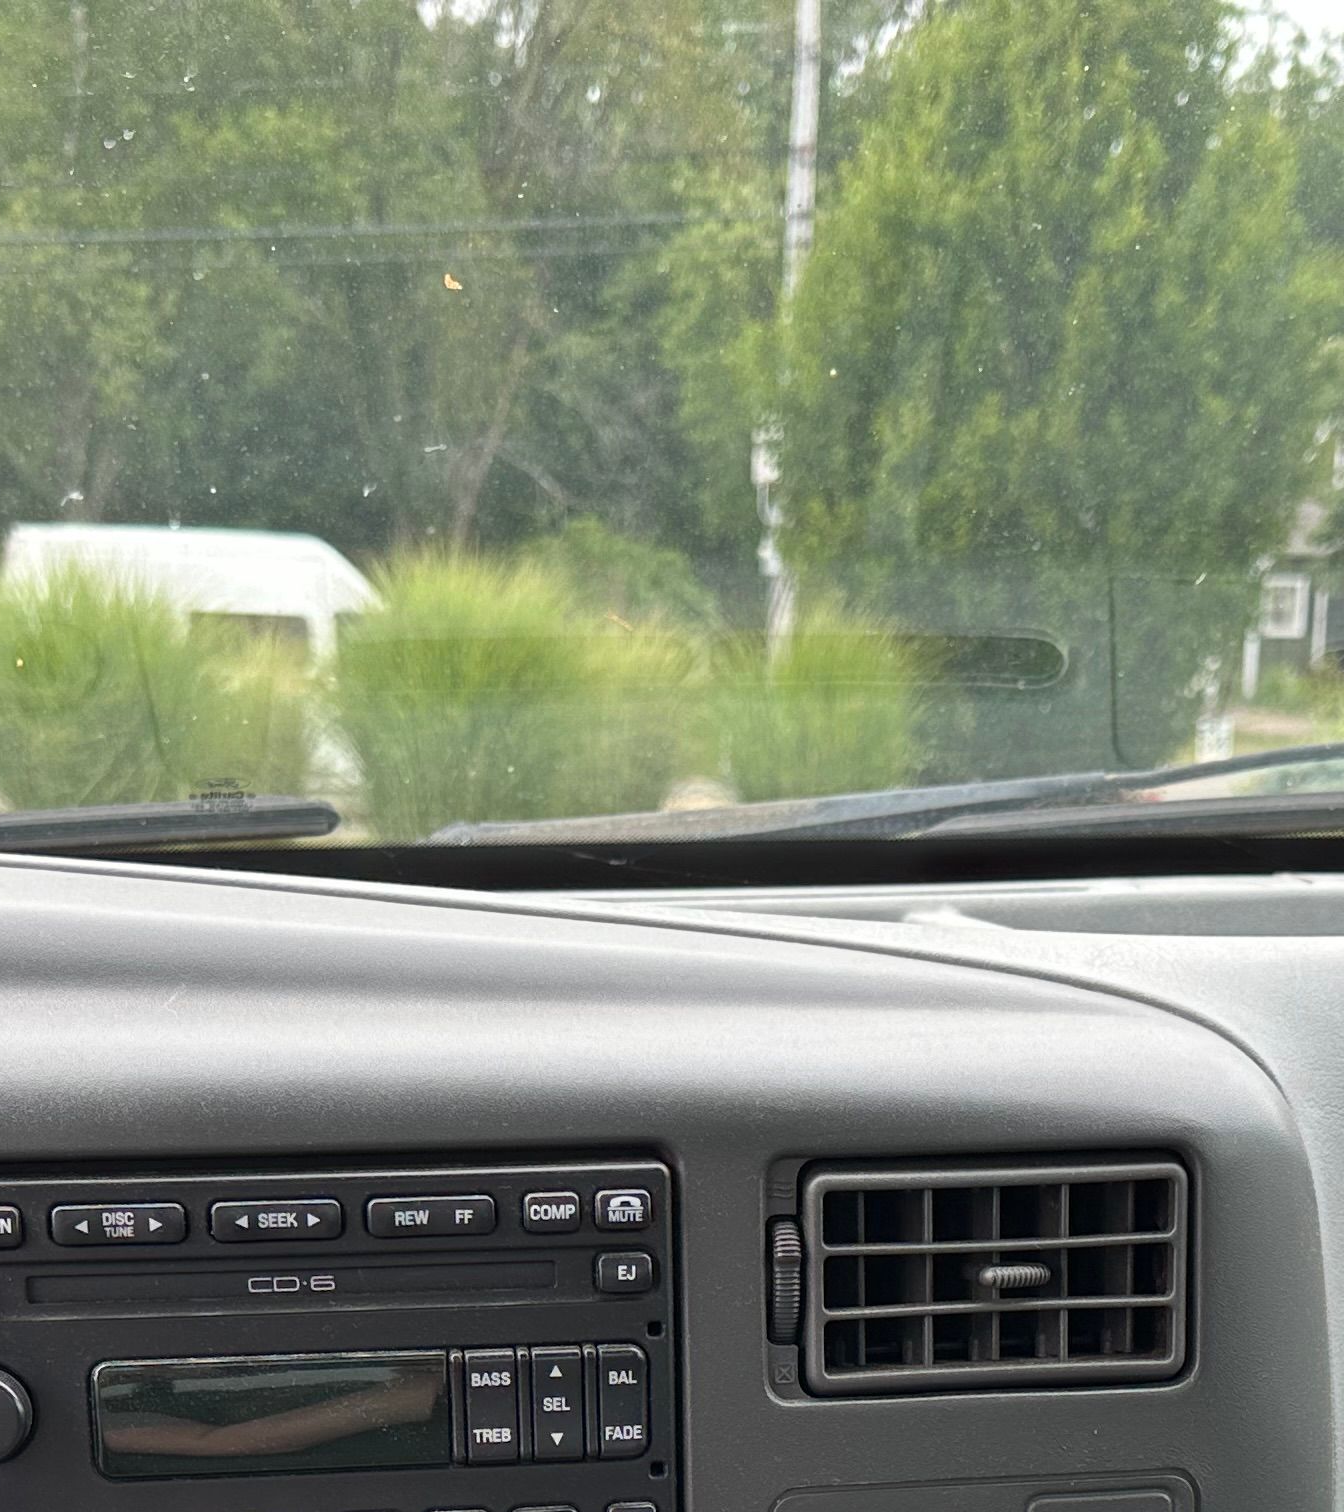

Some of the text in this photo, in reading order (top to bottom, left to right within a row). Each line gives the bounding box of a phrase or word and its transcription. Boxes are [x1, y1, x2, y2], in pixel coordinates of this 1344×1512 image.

[102, 1212, 134, 1226] DISC
[395, 1210, 473, 1226] REW FF
[530, 1205, 575, 1220] COMP
[608, 1210, 643, 1222] MUTE
[258, 1213, 297, 1228] SEEK
[104, 1227, 134, 1238] TUNE
[617, 1266, 636, 1281] EJ
[471, 1372, 511, 1386] BASS
[608, 1371, 637, 1385] BAL
[543, 1397, 570, 1412] SEL
[473, 1429, 511, 1443] TREB
[605, 1426, 642, 1440] FADE
